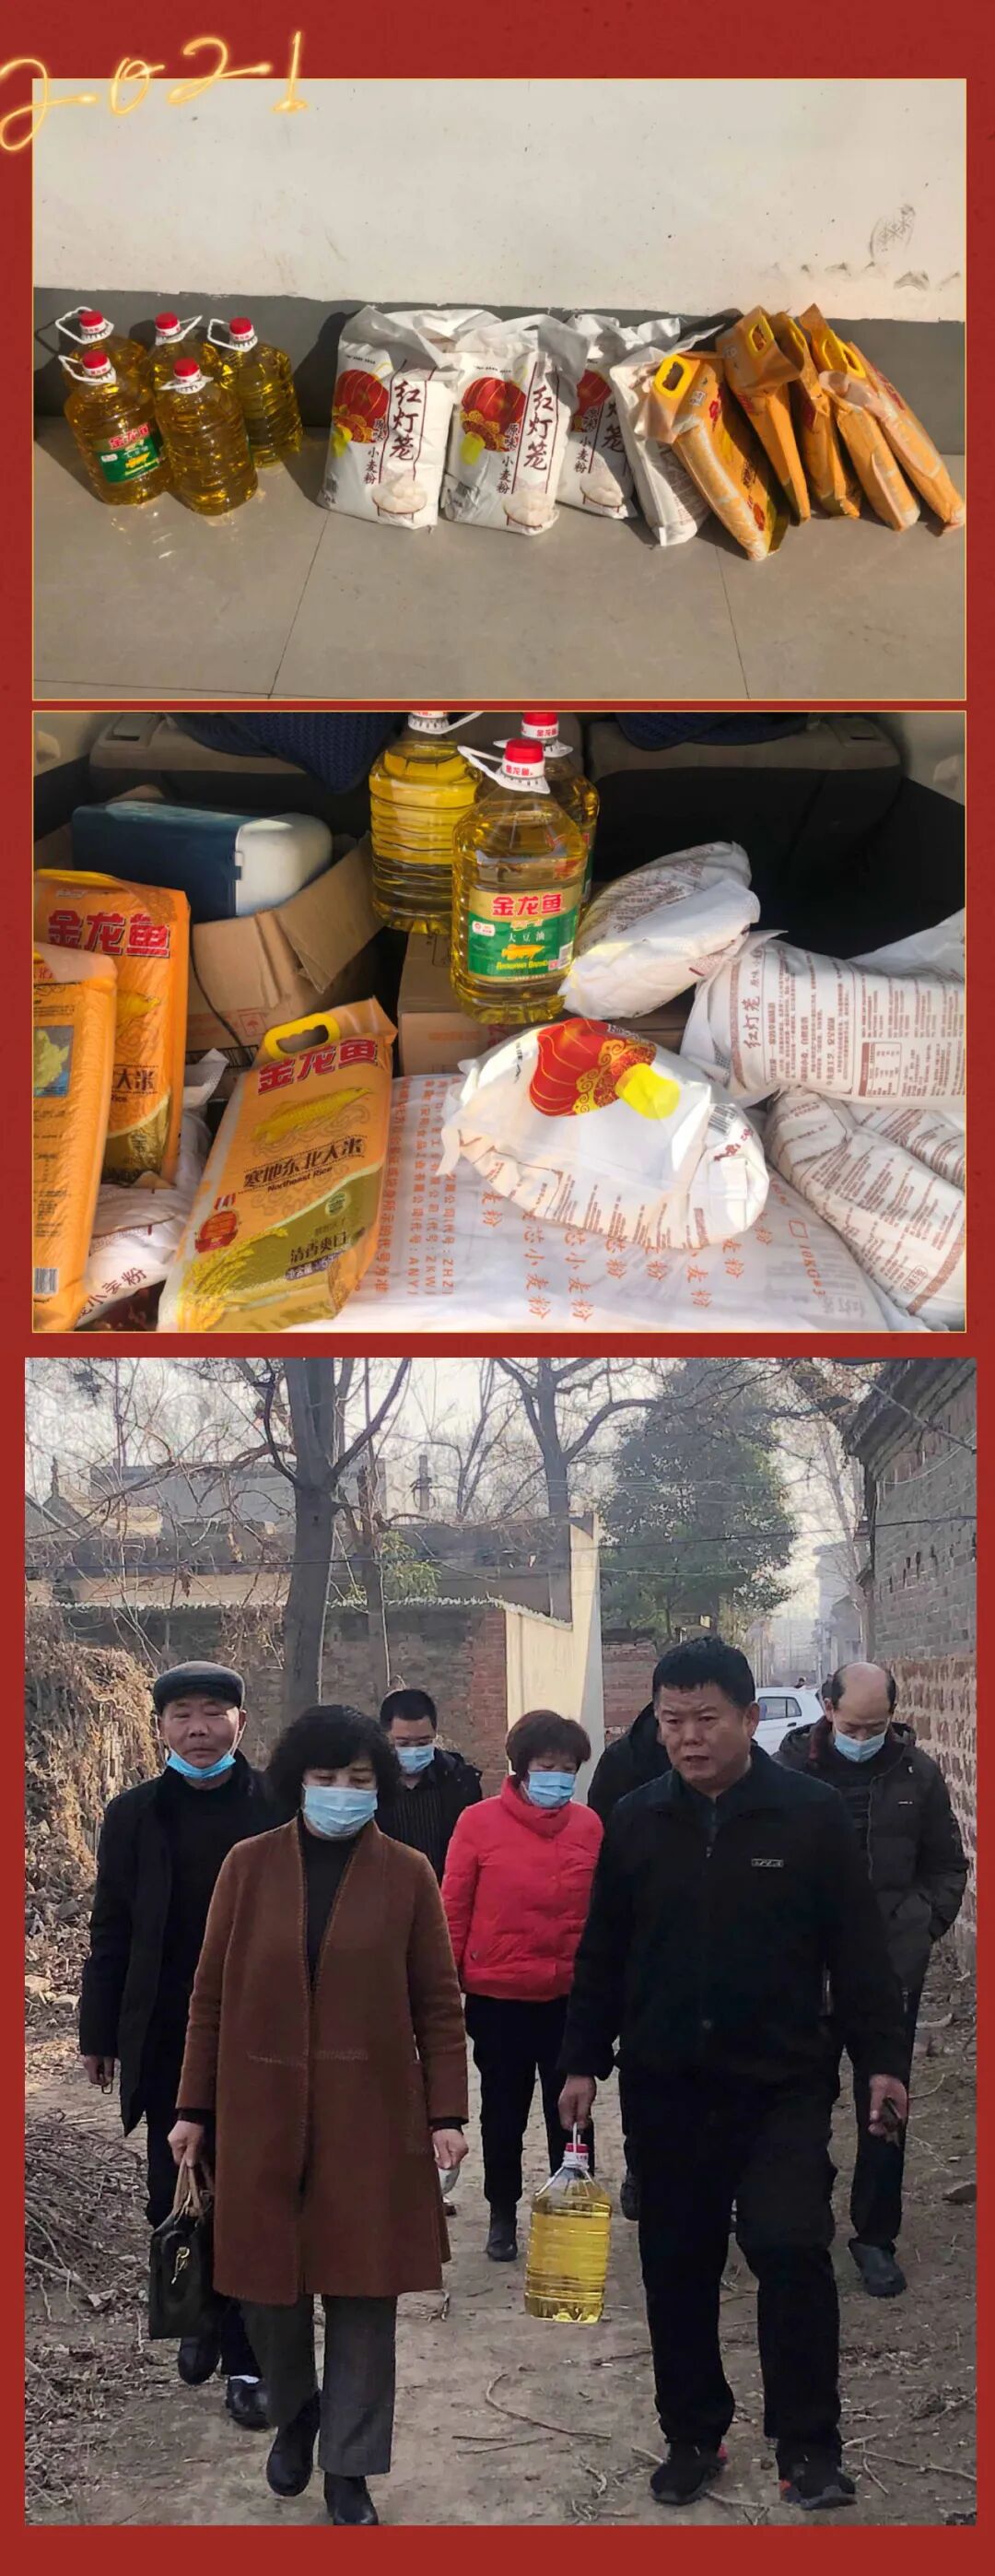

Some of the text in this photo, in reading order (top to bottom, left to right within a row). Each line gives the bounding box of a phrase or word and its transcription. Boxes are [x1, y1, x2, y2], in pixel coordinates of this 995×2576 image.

[389, 380, 422, 461] 红灯笼
[523, 384, 555, 471] 红灯笼
[363, 446, 380, 485] 小麦粉
[496, 455, 515, 495] 小麦粉
[574, 436, 592, 474] 小麦粉
[492, 893, 562, 917] 金龙鱼
[48, 908, 170, 959] 金龙鱼
[743, 994, 761, 1050] 红灯笼
[258, 1039, 379, 1095] 金龙鱼
[243, 1136, 363, 1188] 寒地东北大米
